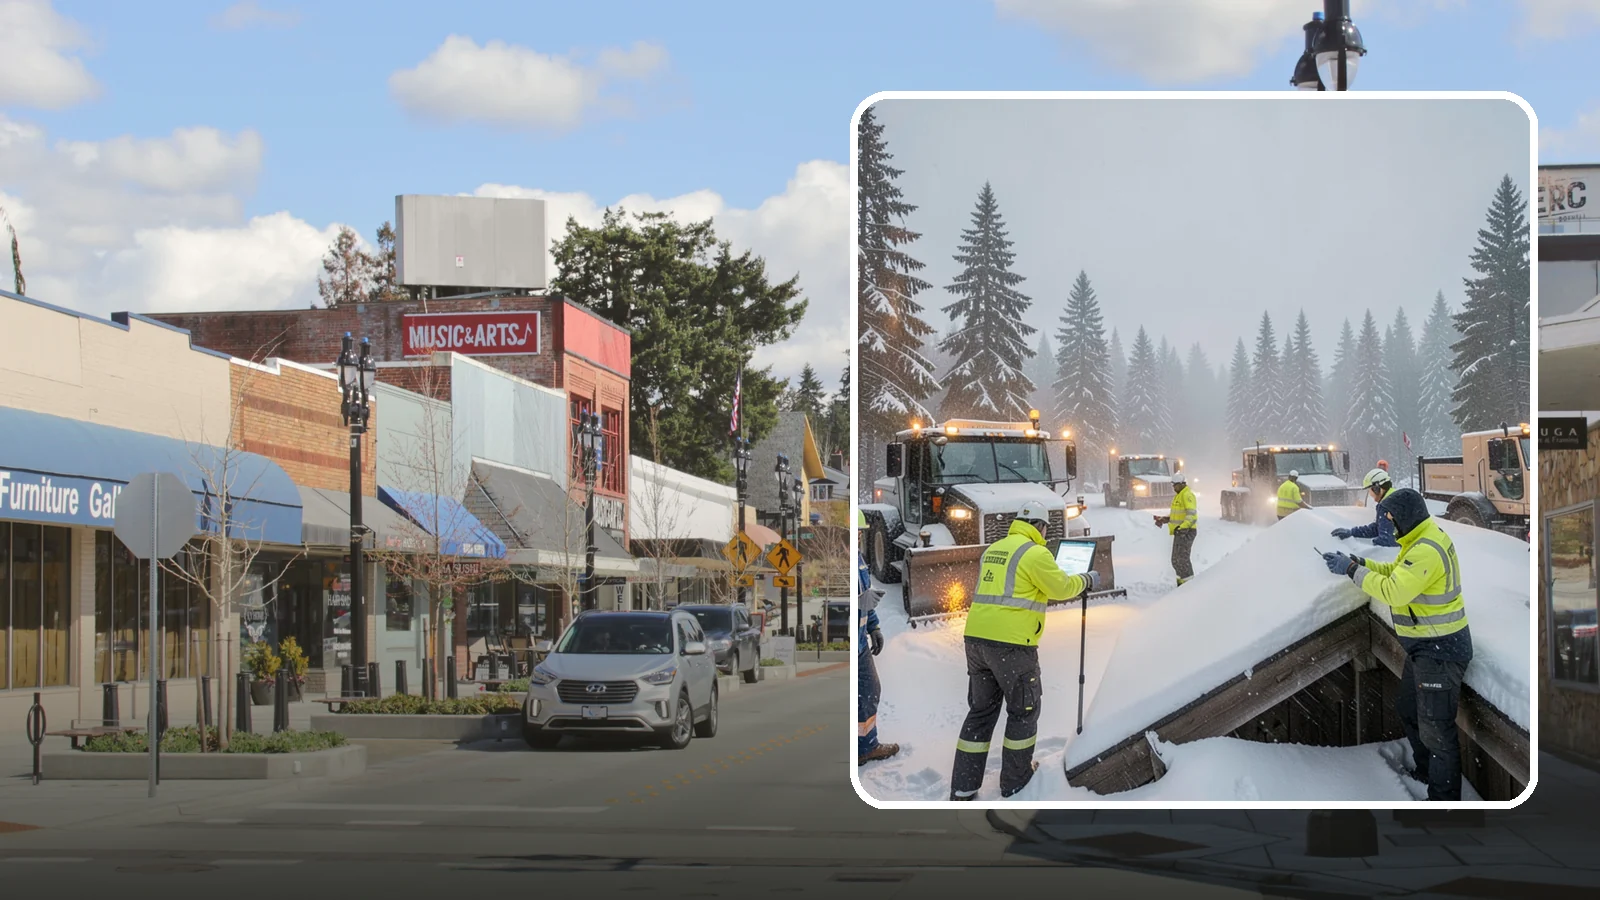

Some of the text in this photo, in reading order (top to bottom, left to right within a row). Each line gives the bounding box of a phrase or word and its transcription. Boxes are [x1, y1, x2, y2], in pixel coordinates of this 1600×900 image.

[1540, 427, 1577, 437] UGA
[0, 471, 79, 515] Furniture
[453, 563, 479, 574] SUSHI
